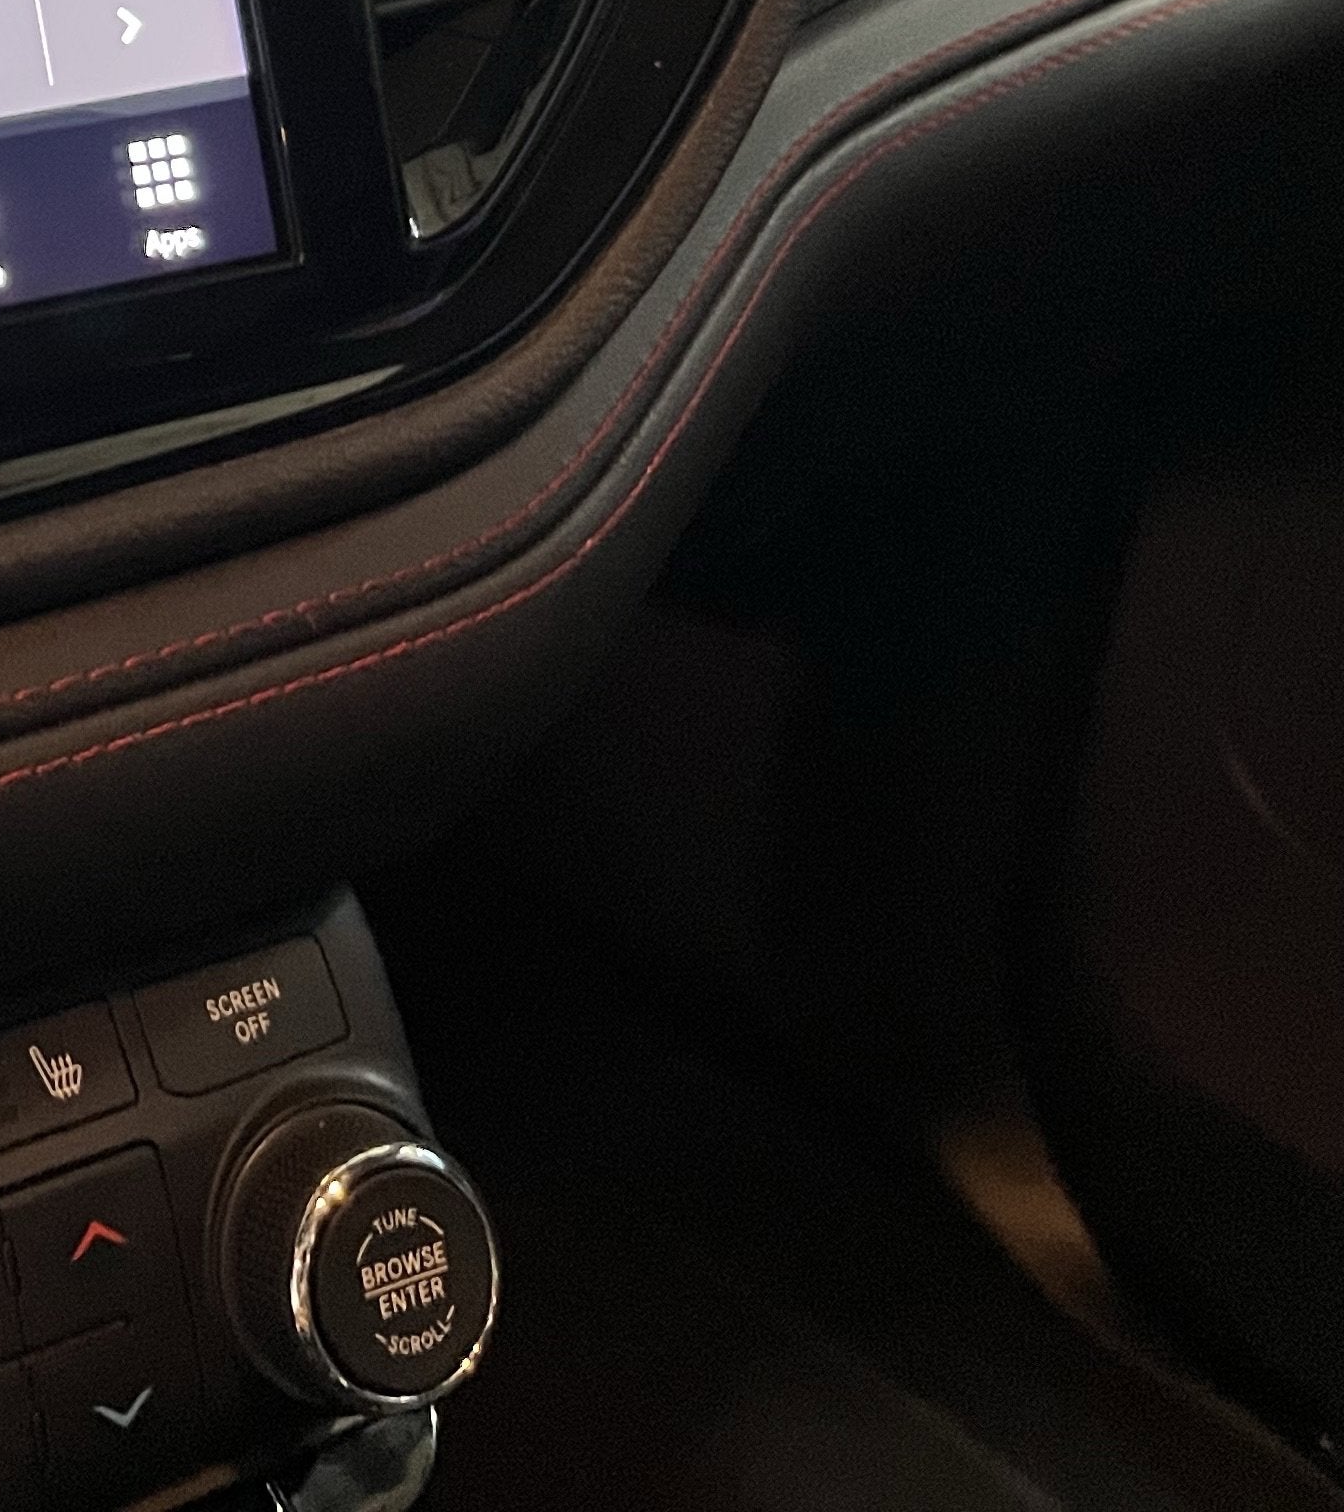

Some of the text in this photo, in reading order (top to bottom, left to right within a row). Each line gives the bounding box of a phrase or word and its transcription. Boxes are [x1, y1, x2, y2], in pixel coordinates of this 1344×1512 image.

[143, 225, 207, 262] Apps
[205, 976, 282, 1022] SCREEN
[233, 1010, 271, 1044] OFF
[371, 1206, 418, 1236] TUNE
[361, 1242, 446, 1289] BROWSE
[379, 1278, 445, 1320] ENTER
[389, 1320, 451, 1356] SCROLL
